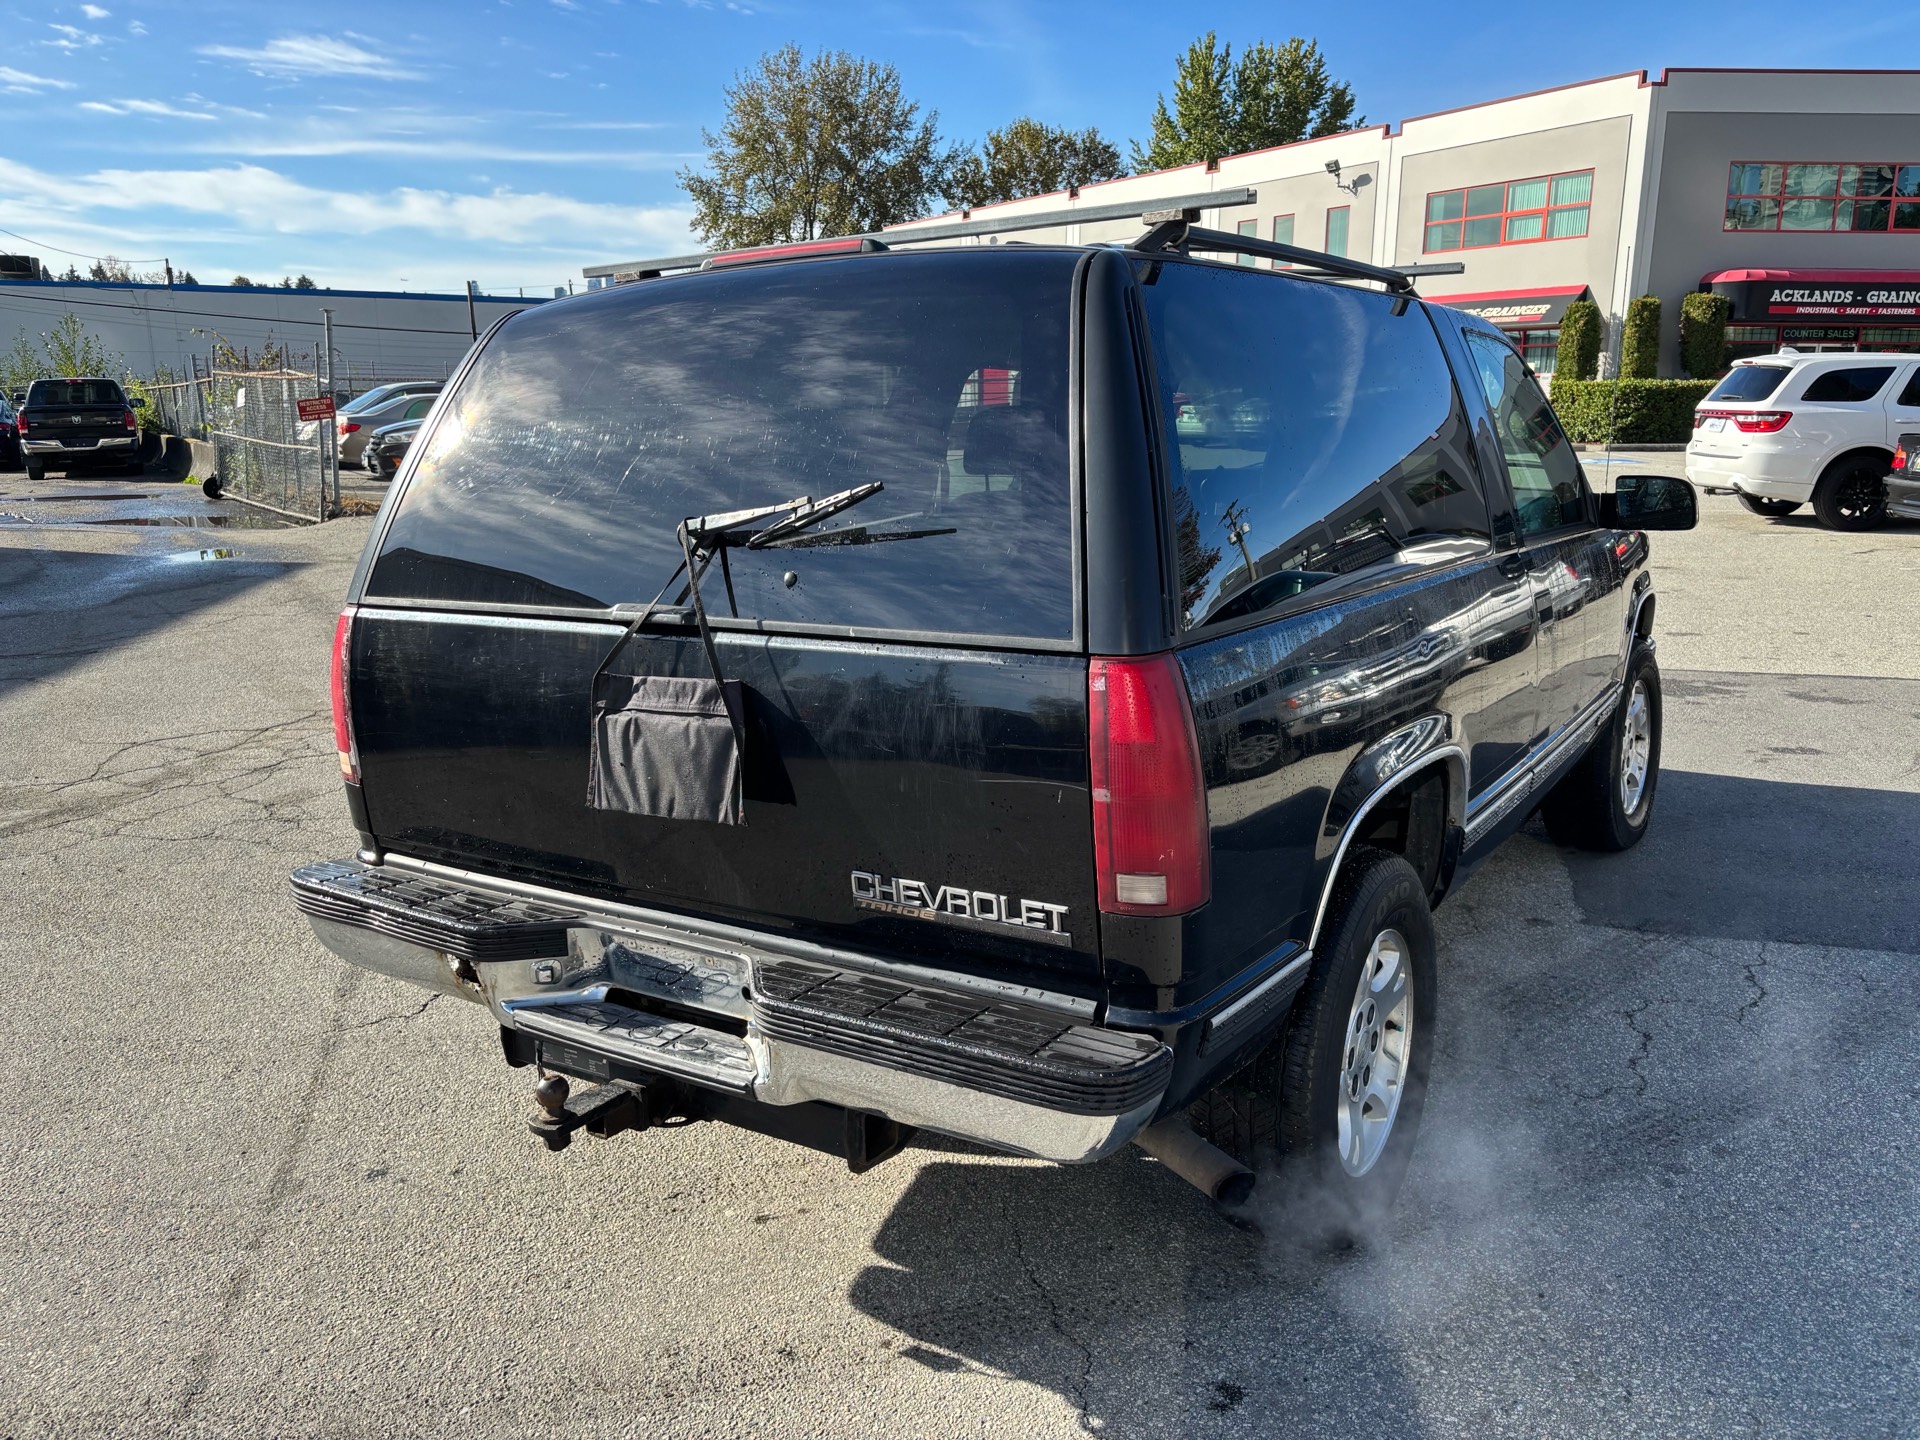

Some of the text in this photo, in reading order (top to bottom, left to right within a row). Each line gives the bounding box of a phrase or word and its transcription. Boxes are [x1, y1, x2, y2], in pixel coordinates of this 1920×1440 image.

[1770, 289, 1853, 303] ACKLANDS
[1796, 306, 1916, 315] INDUSTRIAL SAFETY FASTENERS
[1783, 329, 1855, 338] COUNTER SALES
[851, 870, 1069, 933] CHEVROLET
[856, 898, 936, 921] TAHOE
